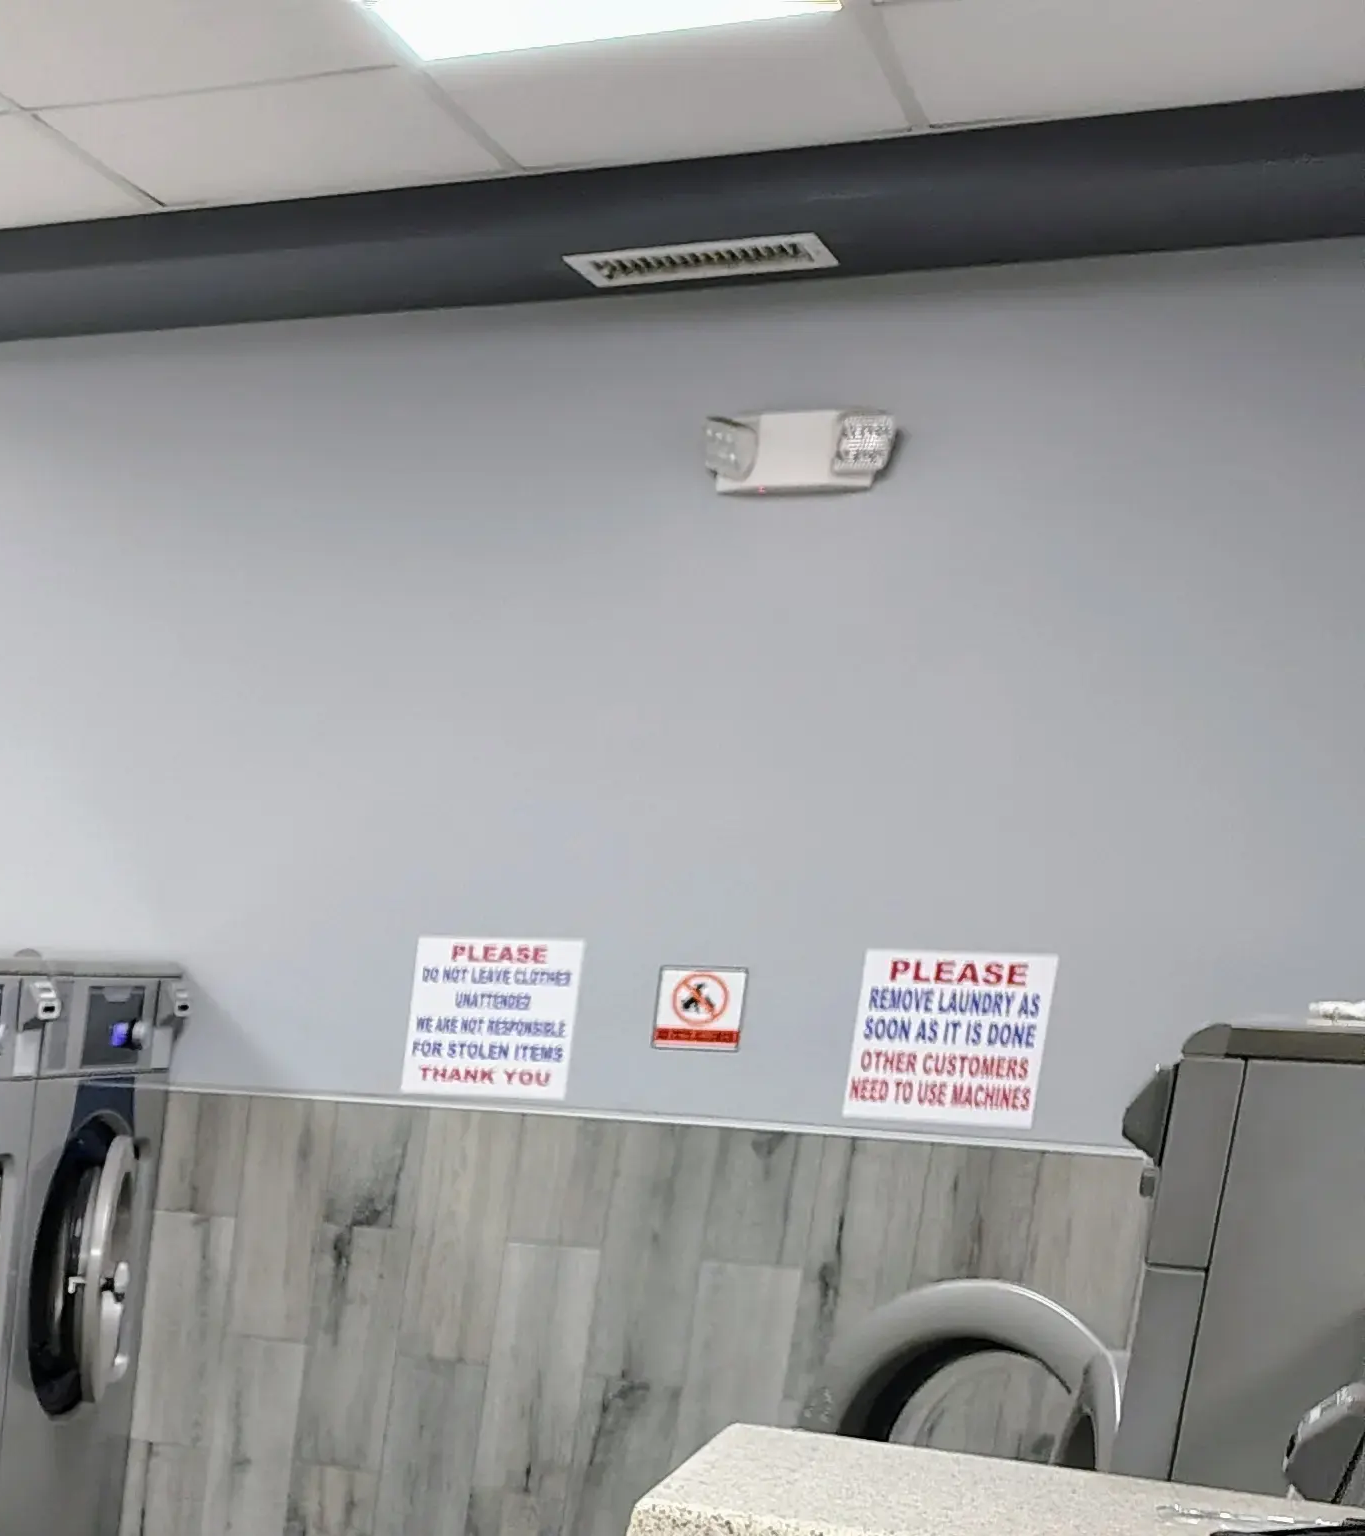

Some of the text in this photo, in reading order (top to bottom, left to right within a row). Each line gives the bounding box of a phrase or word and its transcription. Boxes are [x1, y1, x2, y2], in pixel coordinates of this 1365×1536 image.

[451, 944, 548, 964] PLEASE
[422, 967, 572, 986] DO NOT LEAVE CLOTHES
[890, 959, 1029, 987] PLEASE
[455, 992, 531, 1010] UNATTENDED
[870, 987, 1040, 1018] REMOVE LAUNDRY AS
[416, 1016, 566, 1038] WE ARE NOT RESPONSIBLE
[864, 1016, 1037, 1048] SOON AS IT IS DONE
[412, 1040, 563, 1062] FOR STOLEN ITEMS
[860, 1049, 1029, 1080] OTHER CUSTOMERS
[420, 1066, 552, 1086] THANK YOU
[849, 1077, 1031, 1111] NEED TO USE MACHINES
